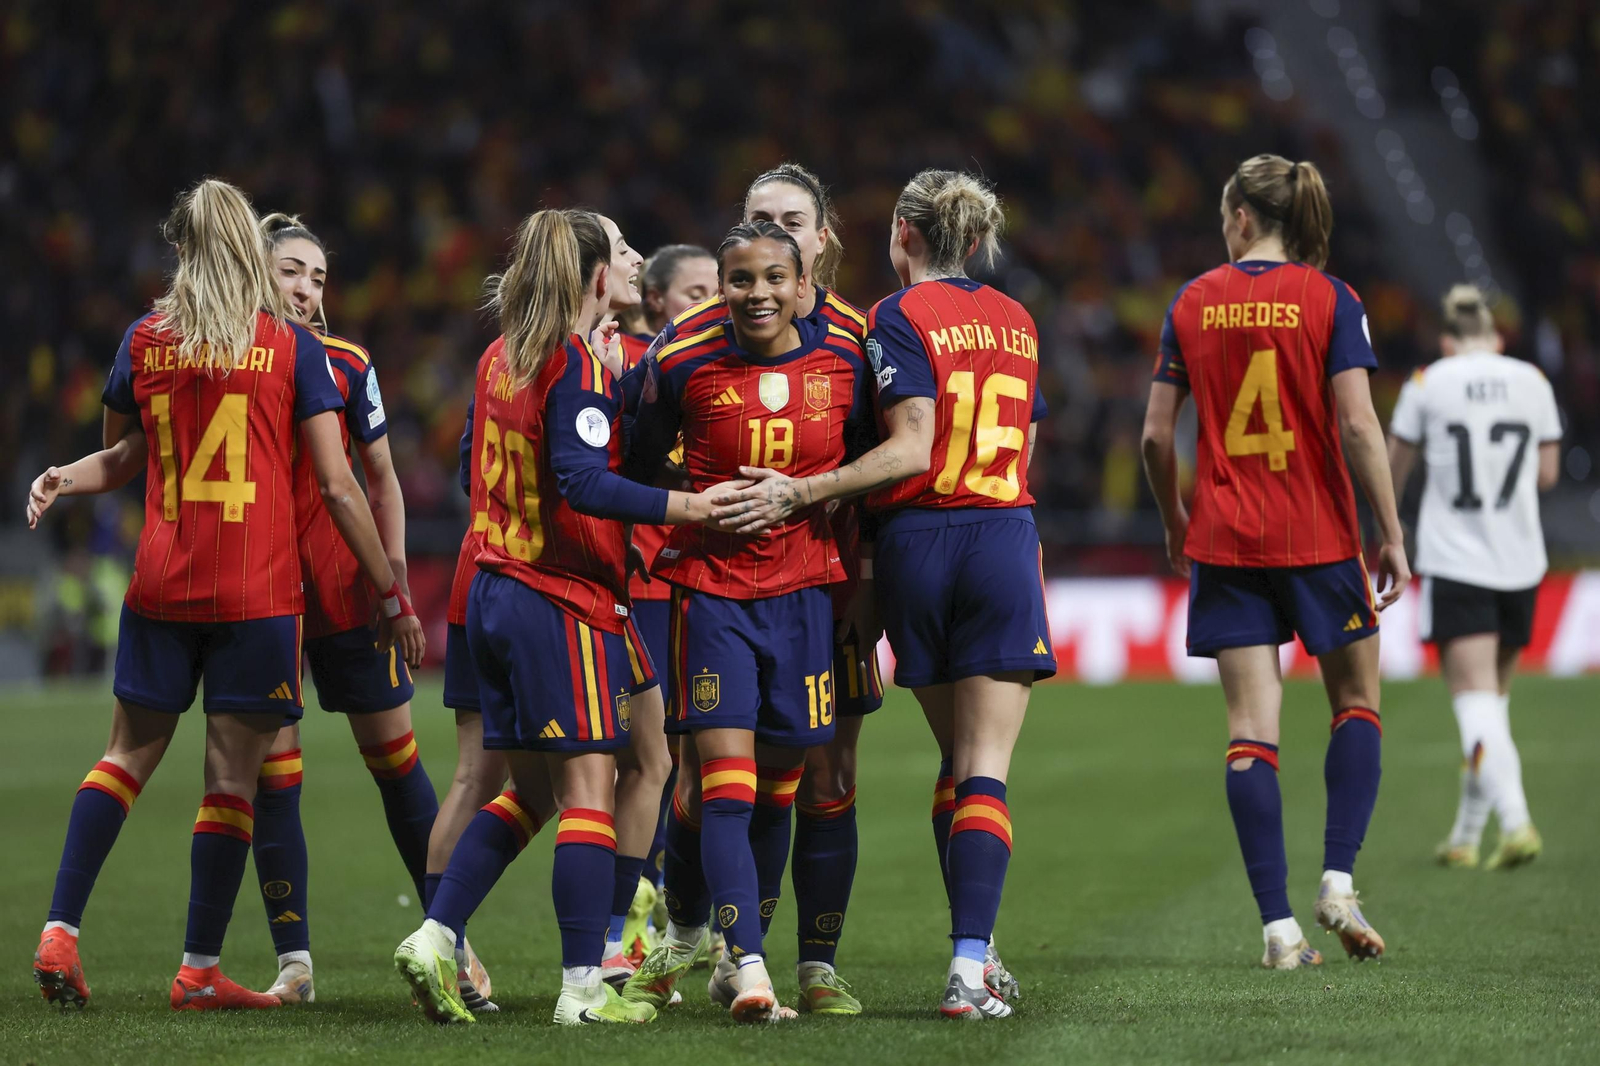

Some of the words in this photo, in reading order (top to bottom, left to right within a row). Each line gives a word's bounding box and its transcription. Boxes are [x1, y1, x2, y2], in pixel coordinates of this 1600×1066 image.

[928, 319, 997, 356] MARÍA
[1001, 327, 1038, 364] LEÓN
[1202, 302, 1300, 331] PAREDES
[748, 418, 794, 469] 18
[934, 371, 1027, 502] 16
[1224, 349, 1296, 471] 4
[150, 392, 257, 523] 14
[1447, 422, 1530, 511] 17
[804, 670, 832, 729] 18
